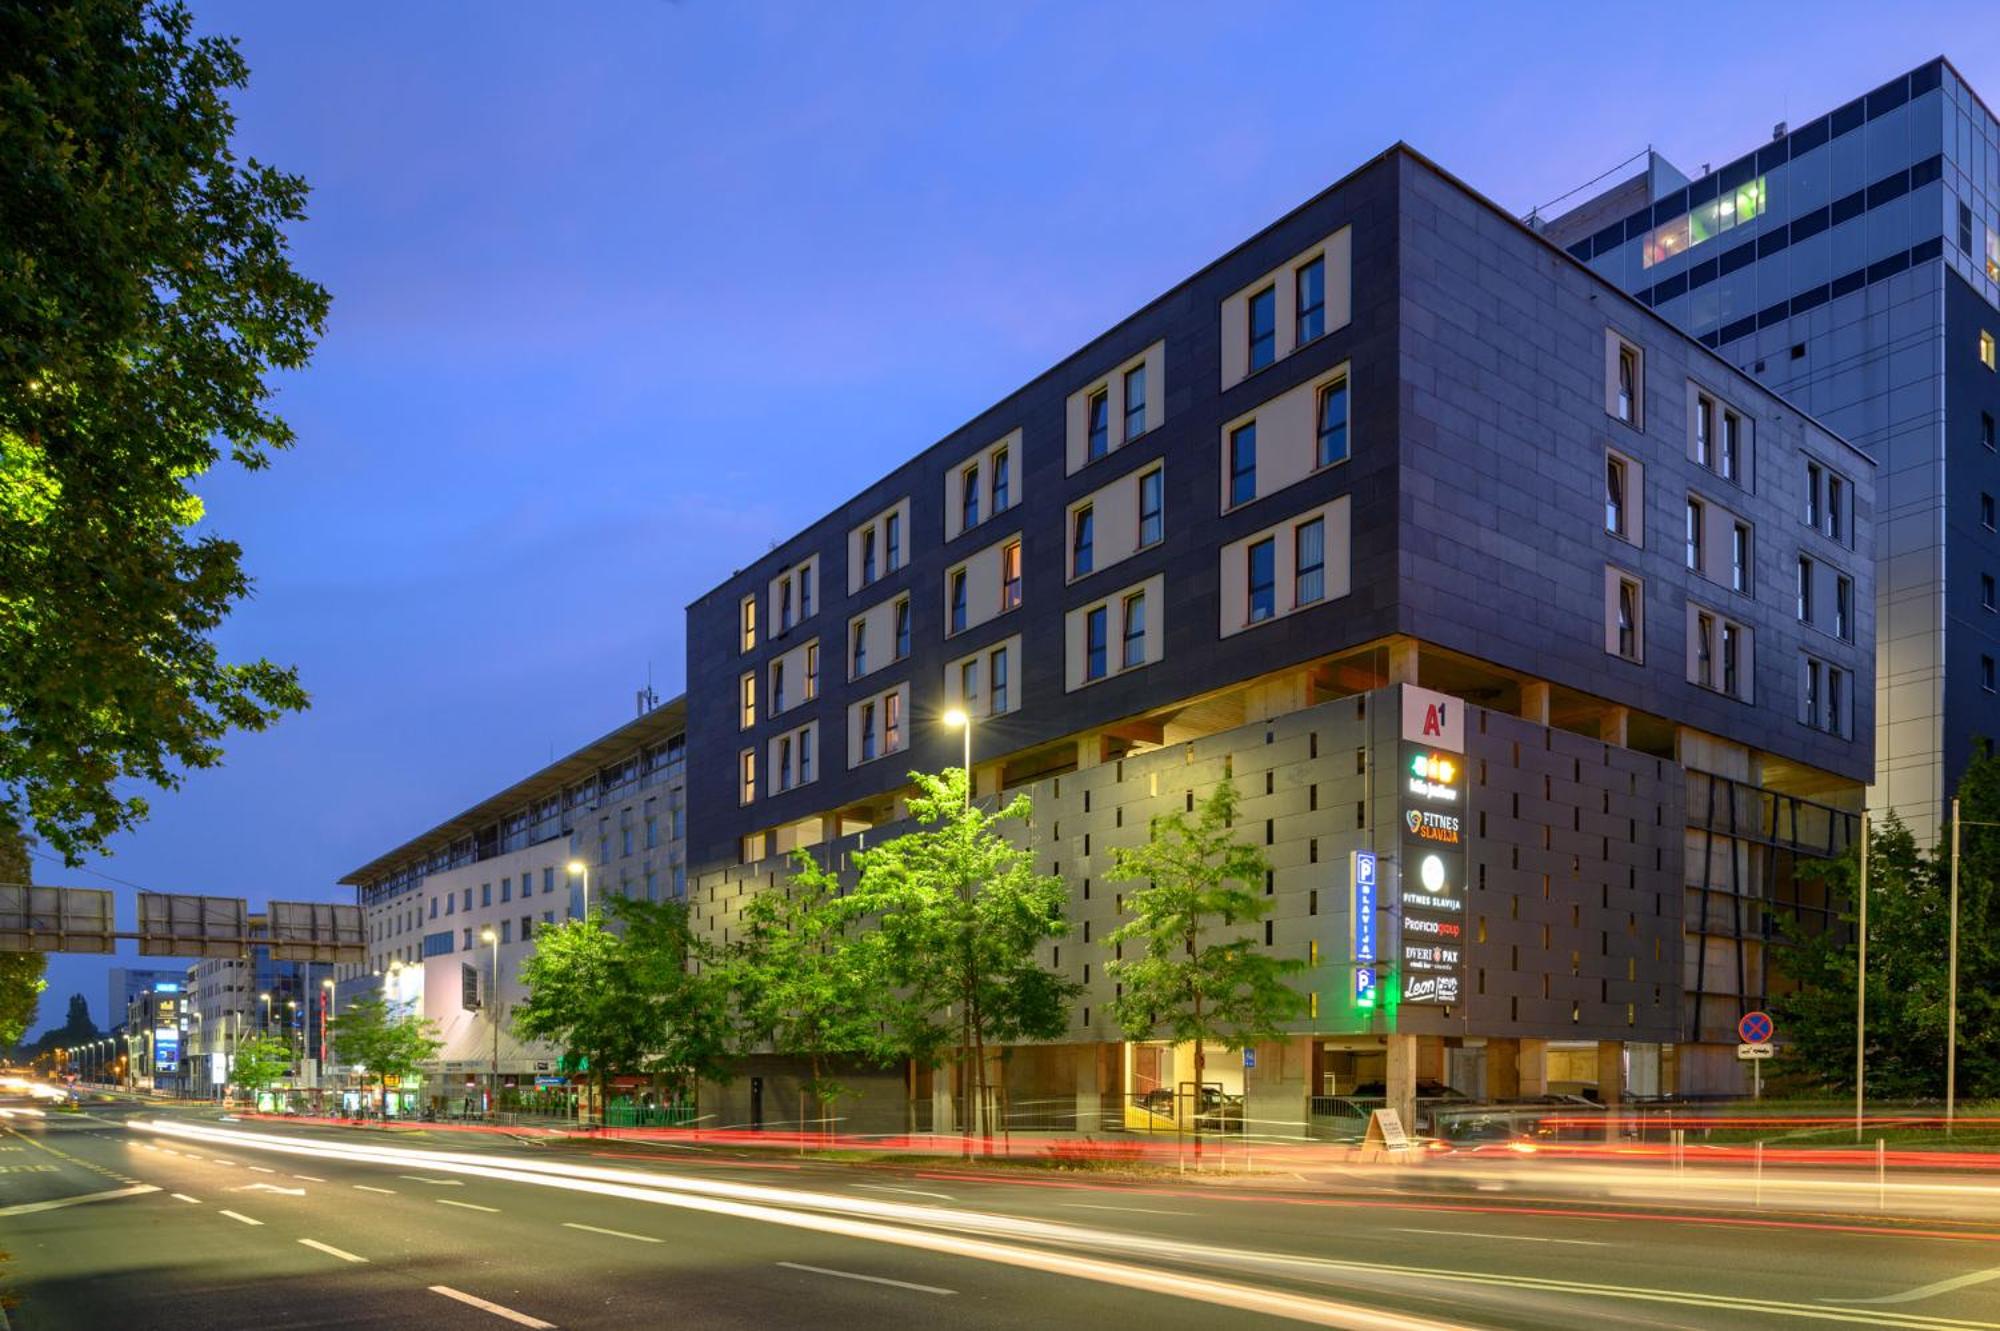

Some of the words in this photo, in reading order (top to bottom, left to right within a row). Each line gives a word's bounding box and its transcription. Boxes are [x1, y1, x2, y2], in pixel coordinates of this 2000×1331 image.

[1422, 702, 1446, 737] A1
[1423, 812, 1459, 831] FITNES
[1420, 825, 1458, 843] SLAVIJA
[1403, 892, 1431, 906] FITNES
[1432, 896, 1461, 911] SLAVIJA
[1442, 950, 1458, 962] PAX
[1404, 976, 1435, 997] Leon
